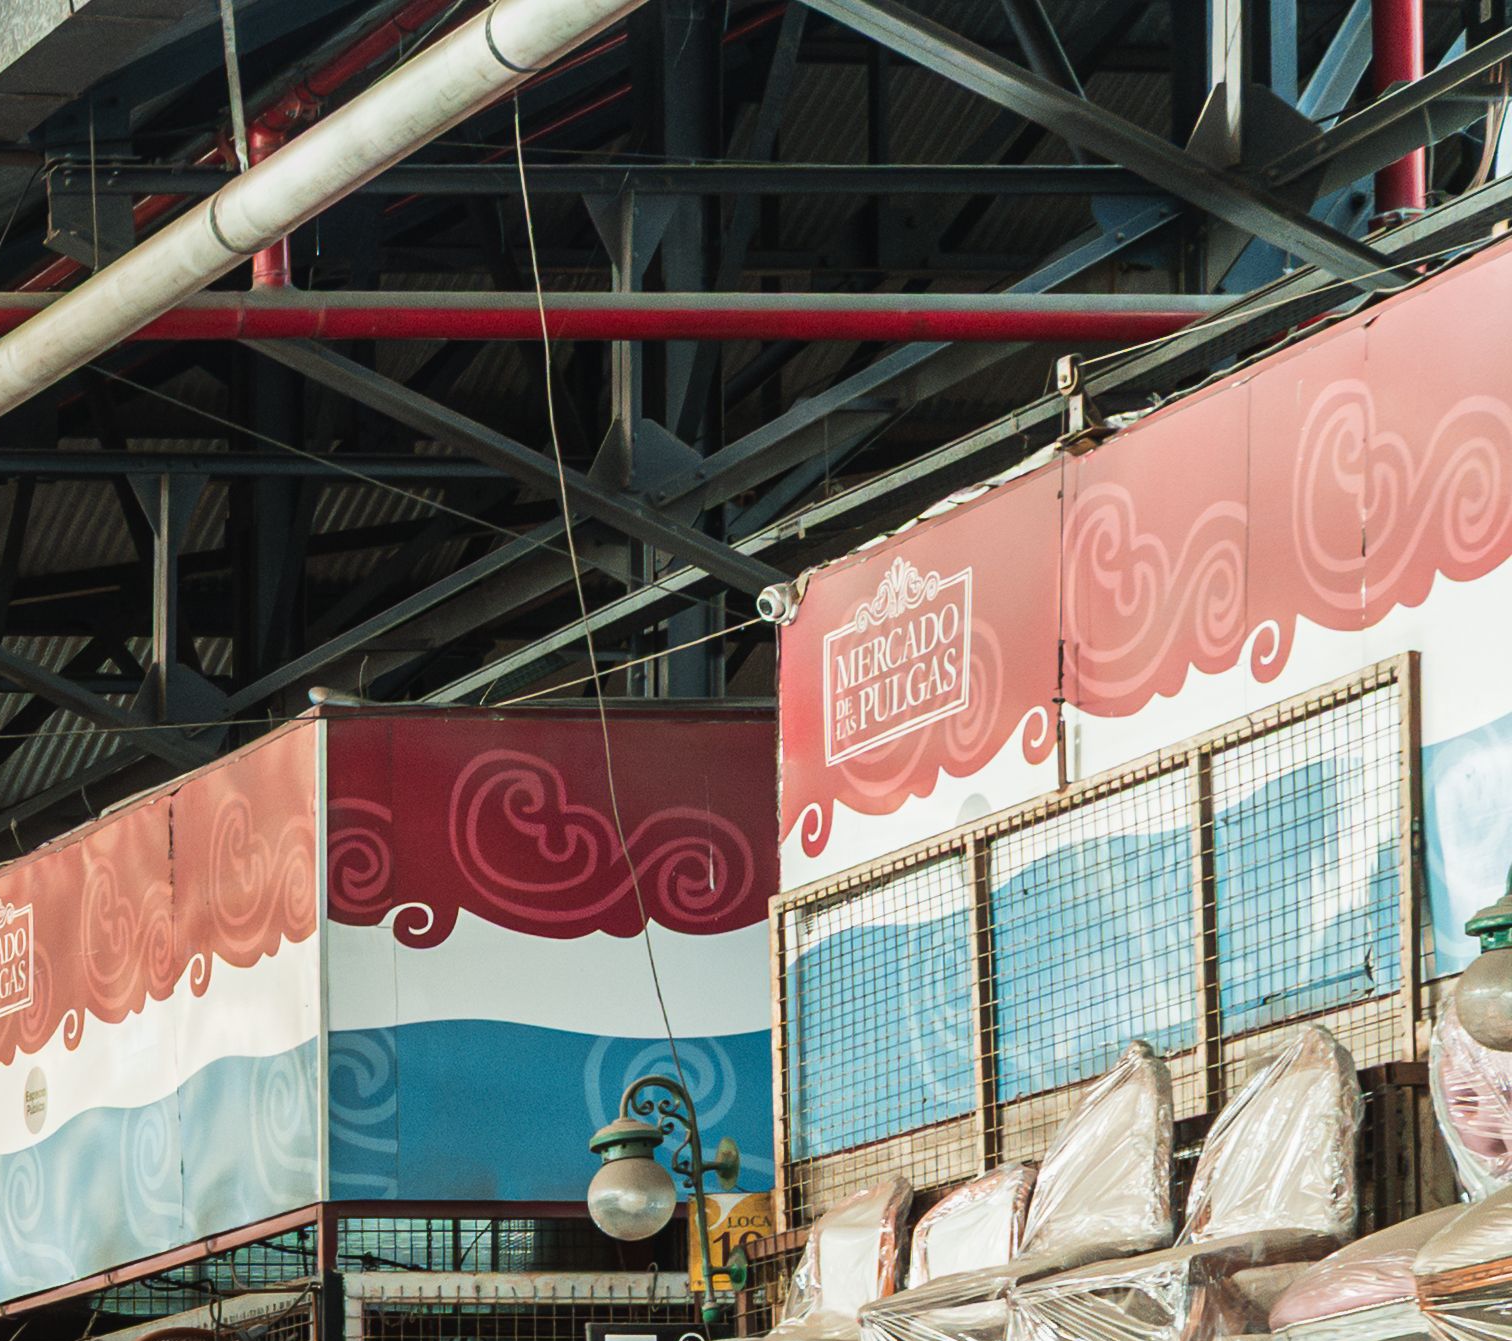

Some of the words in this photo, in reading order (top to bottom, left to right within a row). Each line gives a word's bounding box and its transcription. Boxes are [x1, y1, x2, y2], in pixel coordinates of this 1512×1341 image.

[835, 603, 959, 694] MERCADO
[859, 647, 956, 730] PULGAS
[835, 695, 853, 721] DE
[835, 715, 858, 742] LAS
[727, 1215, 773, 1229] LOCA
